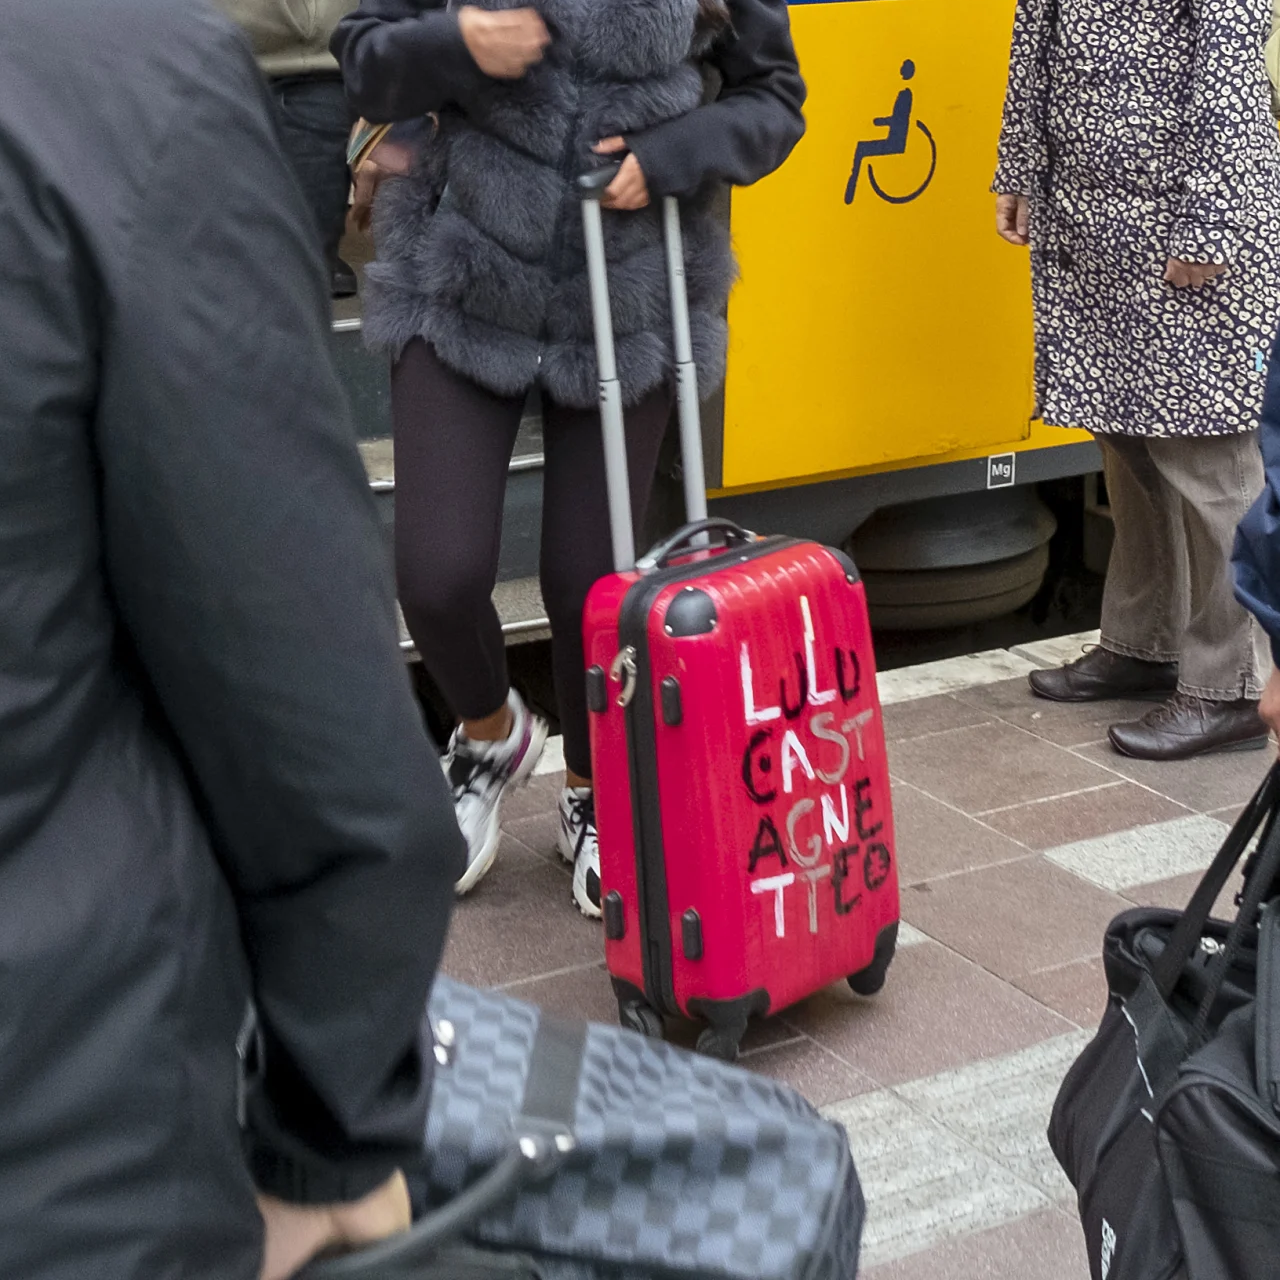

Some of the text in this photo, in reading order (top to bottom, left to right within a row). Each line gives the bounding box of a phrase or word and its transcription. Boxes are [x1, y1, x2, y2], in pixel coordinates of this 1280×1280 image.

[992, 463, 1011, 477] Mg
[740, 596, 861, 725] LULU
[742, 708, 874, 804] CAST
[748, 777, 883, 873] AGNE
